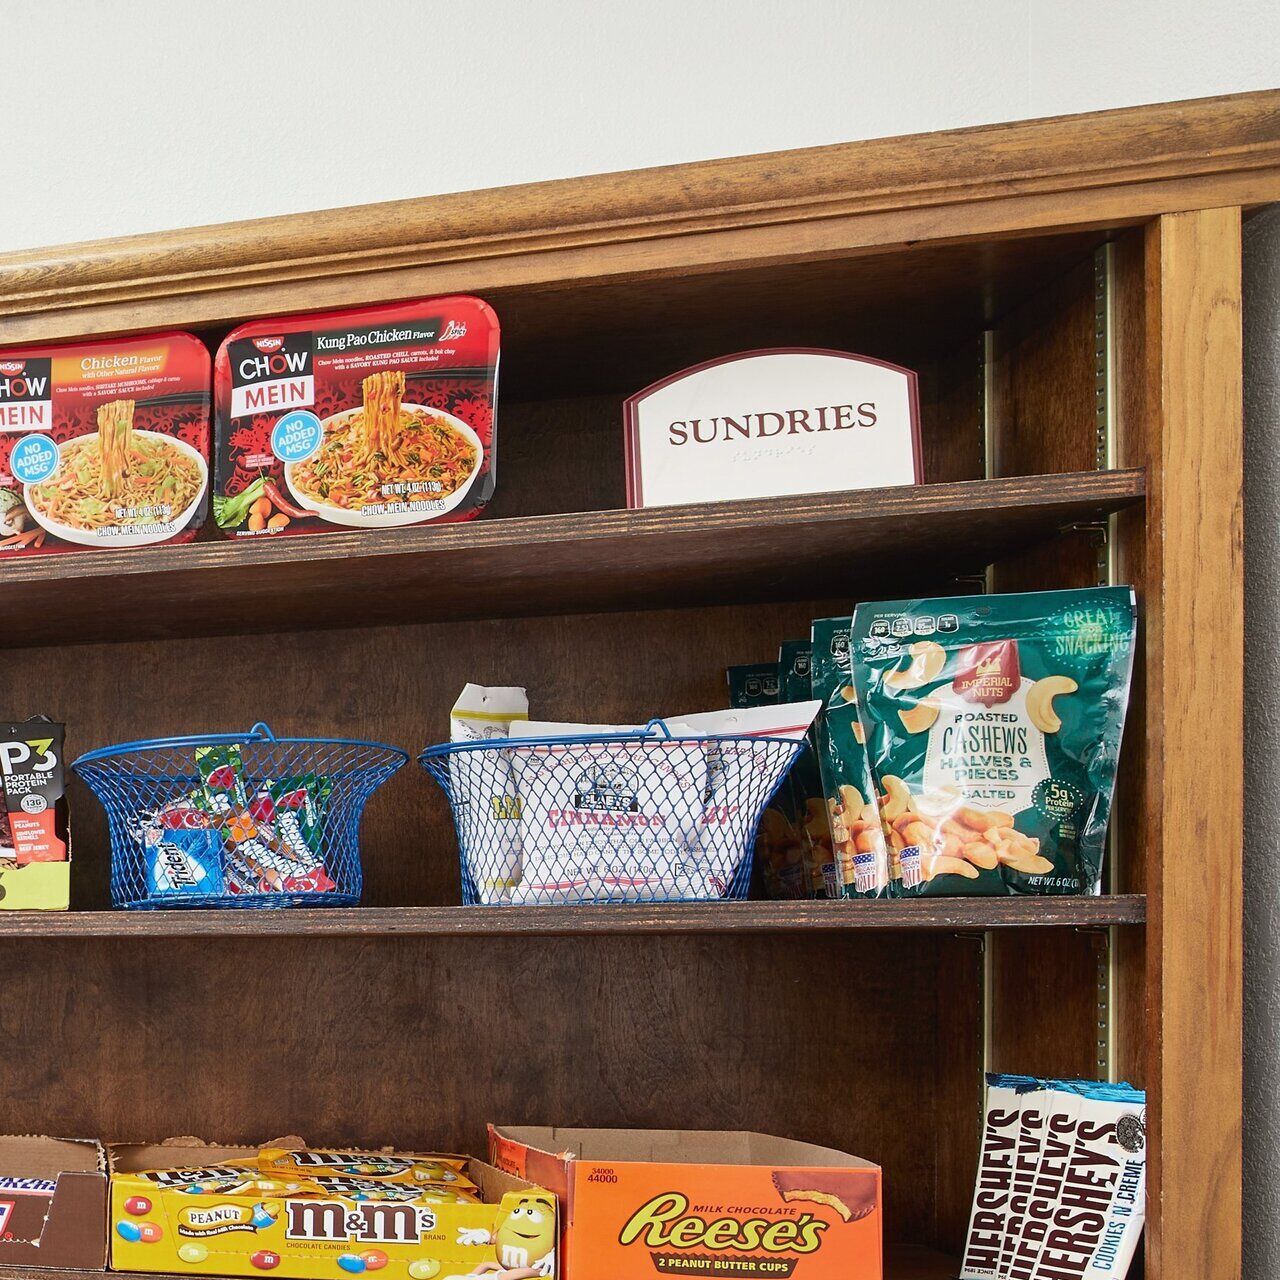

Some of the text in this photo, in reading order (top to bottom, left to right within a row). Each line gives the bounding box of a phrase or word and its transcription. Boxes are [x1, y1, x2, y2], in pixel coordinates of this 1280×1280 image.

[256, 339, 281, 348] NISSIN
[317, 329, 434, 350] Kung Pao Chicken Flavor
[0, 362, 23, 370] NISSIN
[81, 356, 138, 370] Chicken
[239, 352, 307, 380] CHOW
[245, 381, 305, 409] MEIN
[286, 420, 303, 432] NO
[668, 401, 878, 447] SUNDRIES
[278, 427, 315, 448] ADDED
[24, 443, 41, 454] NO
[286, 441, 311, 456] MSG
[17, 451, 52, 467] ADDED
[24, 464, 48, 477] MSG
[1064, 607, 1115, 628] GREAT
[1056, 633, 1128, 656] SNACKING
[962, 677, 1012, 689] IMPERIAL
[973, 687, 1003, 697] NUTS
[955, 713, 1018, 723] ROASTED
[943, 726, 1028, 755] CASHEWS
[941, 755, 1012, 769] HALVES
[4, 772, 53, 782] PORTABLE
[955, 769, 1019, 781] PIECES
[6, 779, 47, 789] PROTEIN
[6, 787, 31, 795] PACK
[962, 789, 1015, 799] SALTED
[1051, 784, 1068, 801] 5g
[1045, 799, 1074, 808] Protein
[588, 1174, 618, 1184] 44000
[190, 1209, 240, 1224] PEANUT
[693, 1205, 797, 1215] MILK CHOCOLATE
[1093, 1159, 1145, 1271] COOKIES CREME
[620, 1192, 829, 1252] Reese's
[668, 1259, 788, 1272] PEANUT BUTTER CUPS
